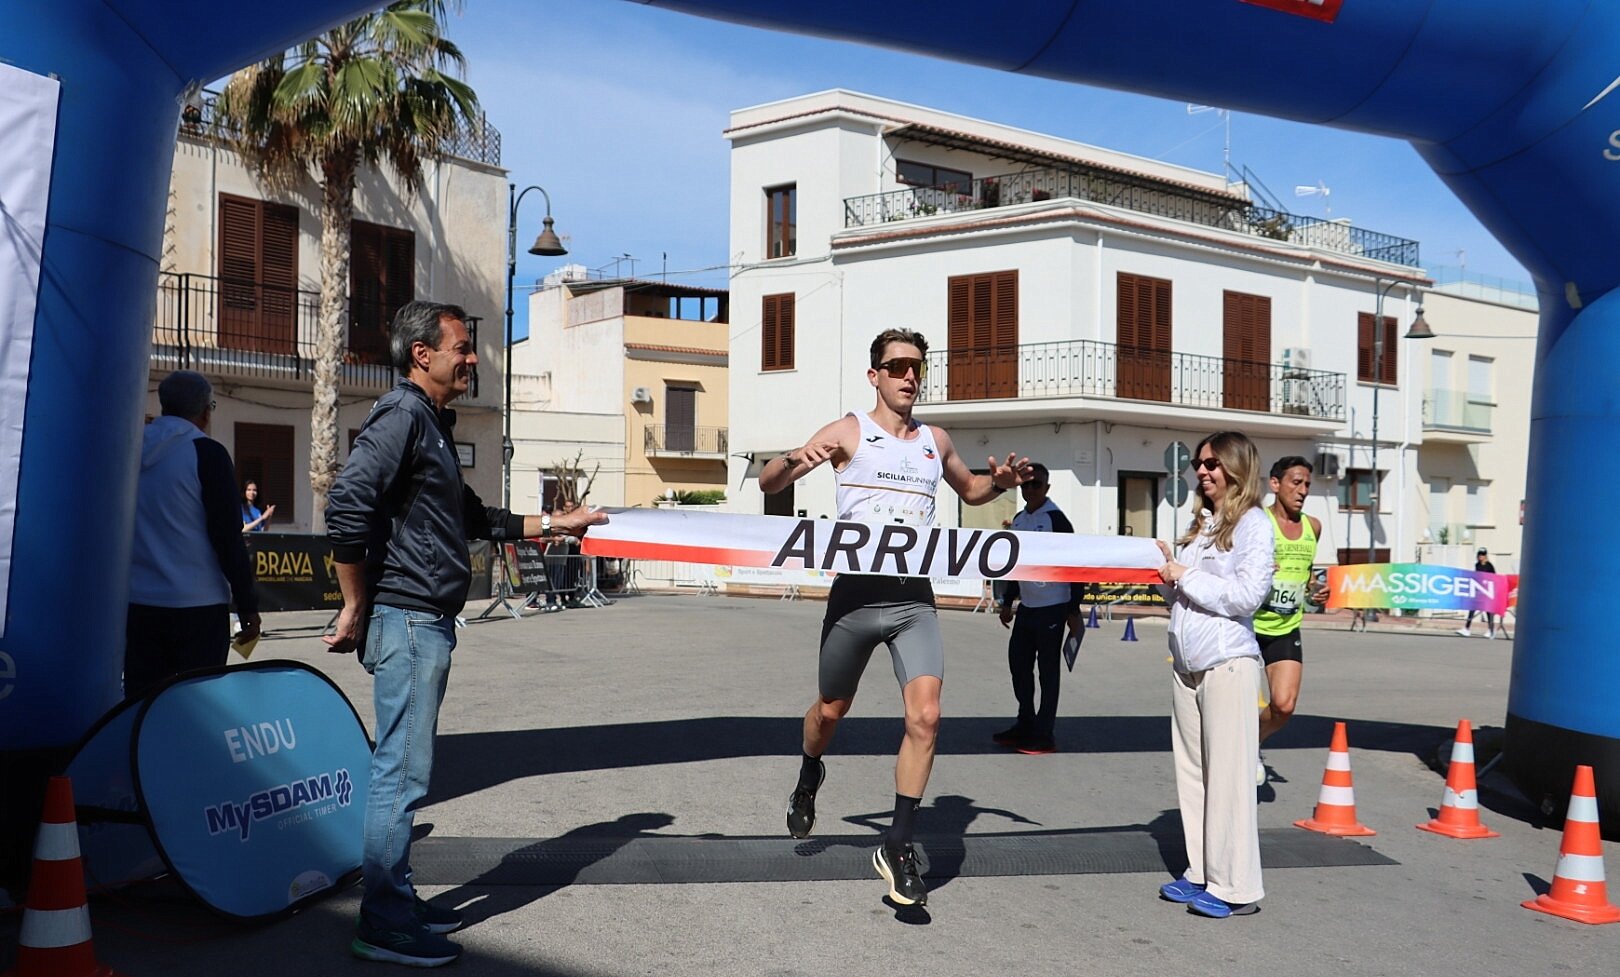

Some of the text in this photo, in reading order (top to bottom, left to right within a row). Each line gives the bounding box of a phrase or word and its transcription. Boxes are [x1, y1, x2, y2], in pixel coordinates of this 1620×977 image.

[256, 551, 314, 575] BRAVA
[771, 519, 1020, 578] ARRIVO
[1340, 573, 1495, 600] MASSIGEN
[224, 718, 297, 763] ENDU
[205, 774, 334, 842] MySDAM
[277, 803, 337, 830] OFFICIAL TIMER
